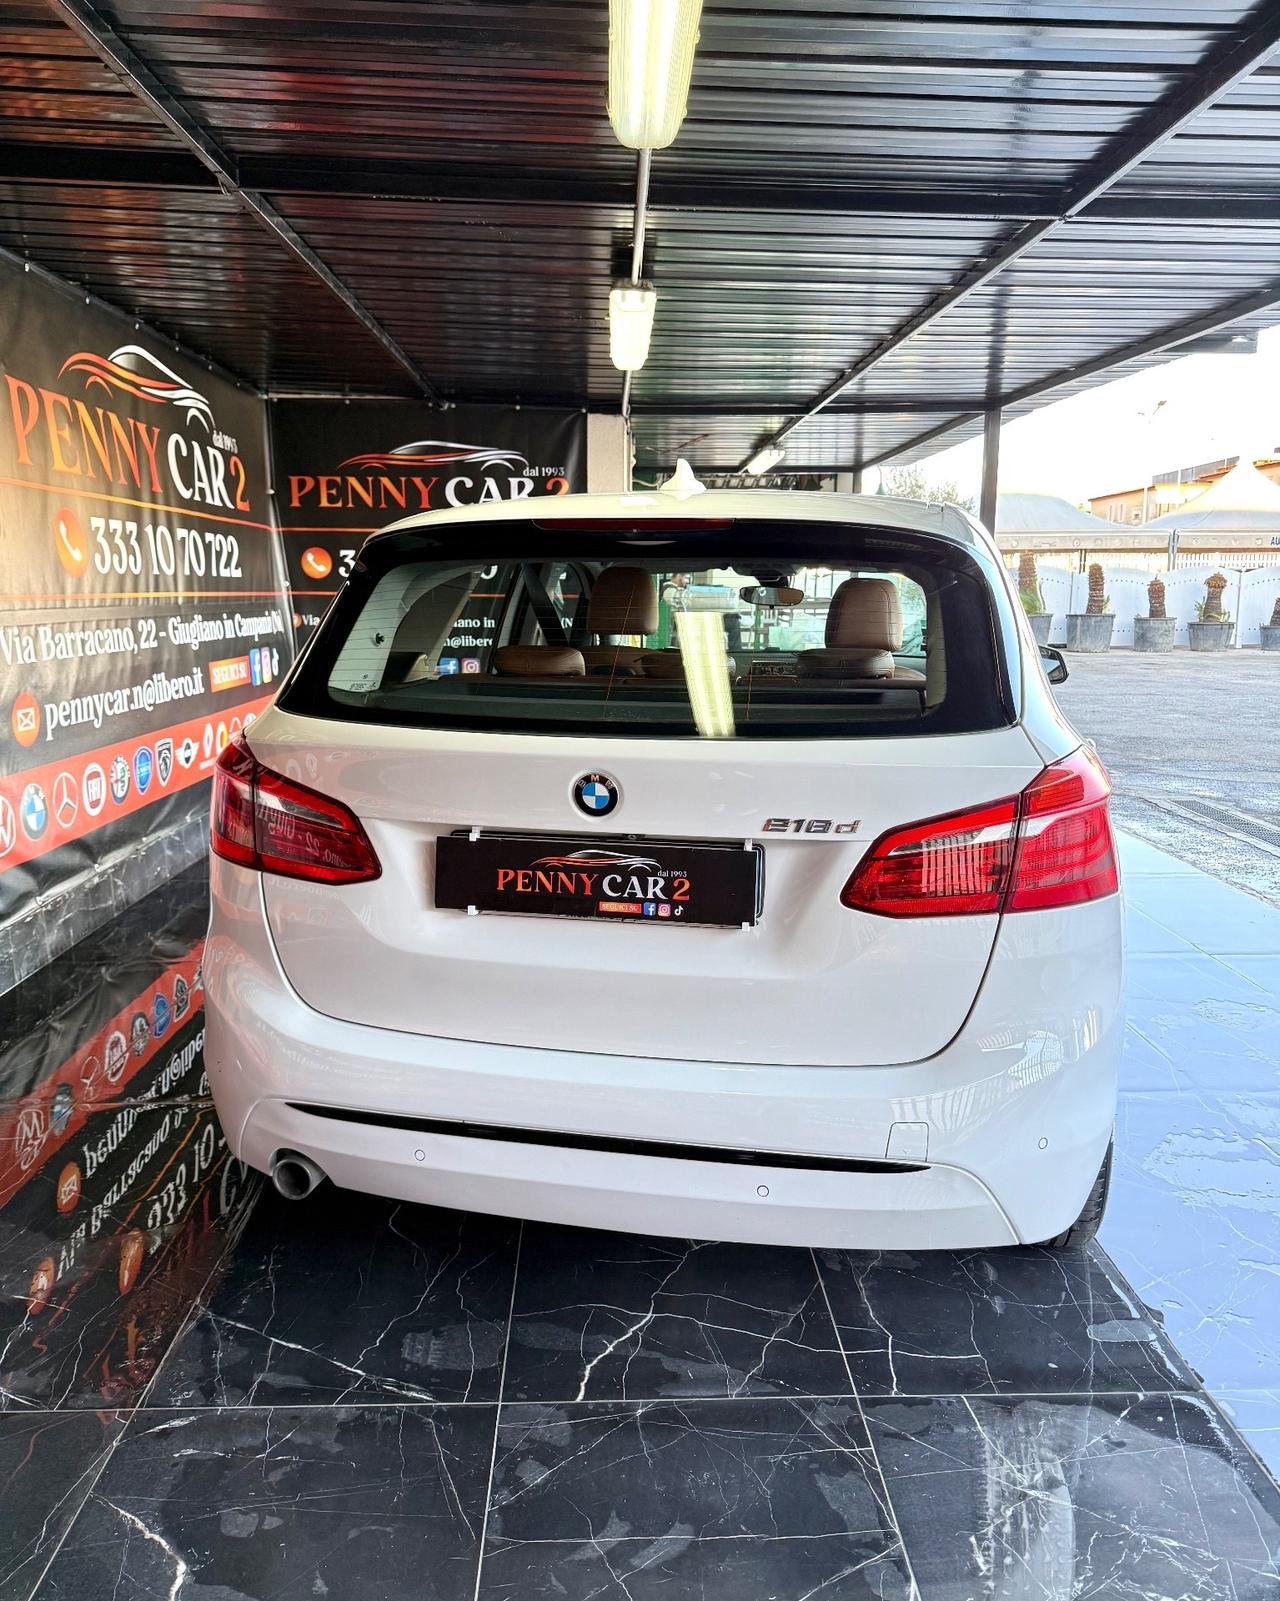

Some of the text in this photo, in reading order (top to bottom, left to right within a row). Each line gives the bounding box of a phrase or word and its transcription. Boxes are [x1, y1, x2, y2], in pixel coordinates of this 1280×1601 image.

[5, 374, 250, 512] PENNY CAR 2
[523, 466, 565, 477] dal 1993
[288, 475, 439, 509] PENNY
[445, 477, 534, 508] CAR
[90, 517, 242, 578] 333 10 70 722
[302, 614, 320, 626] Via
[0, 626, 37, 665] Via
[37, 623, 138, 662] Barracano,
[138, 618, 158, 649] 22
[168, 614, 224, 650] Giugliano
[222, 613, 236, 638] in
[44, 667, 205, 741] pennycar.n@libero.it
[762, 818, 861, 833] 218d
[496, 868, 690, 900] PENNY CAR 2
[657, 869, 669, 877] dal
